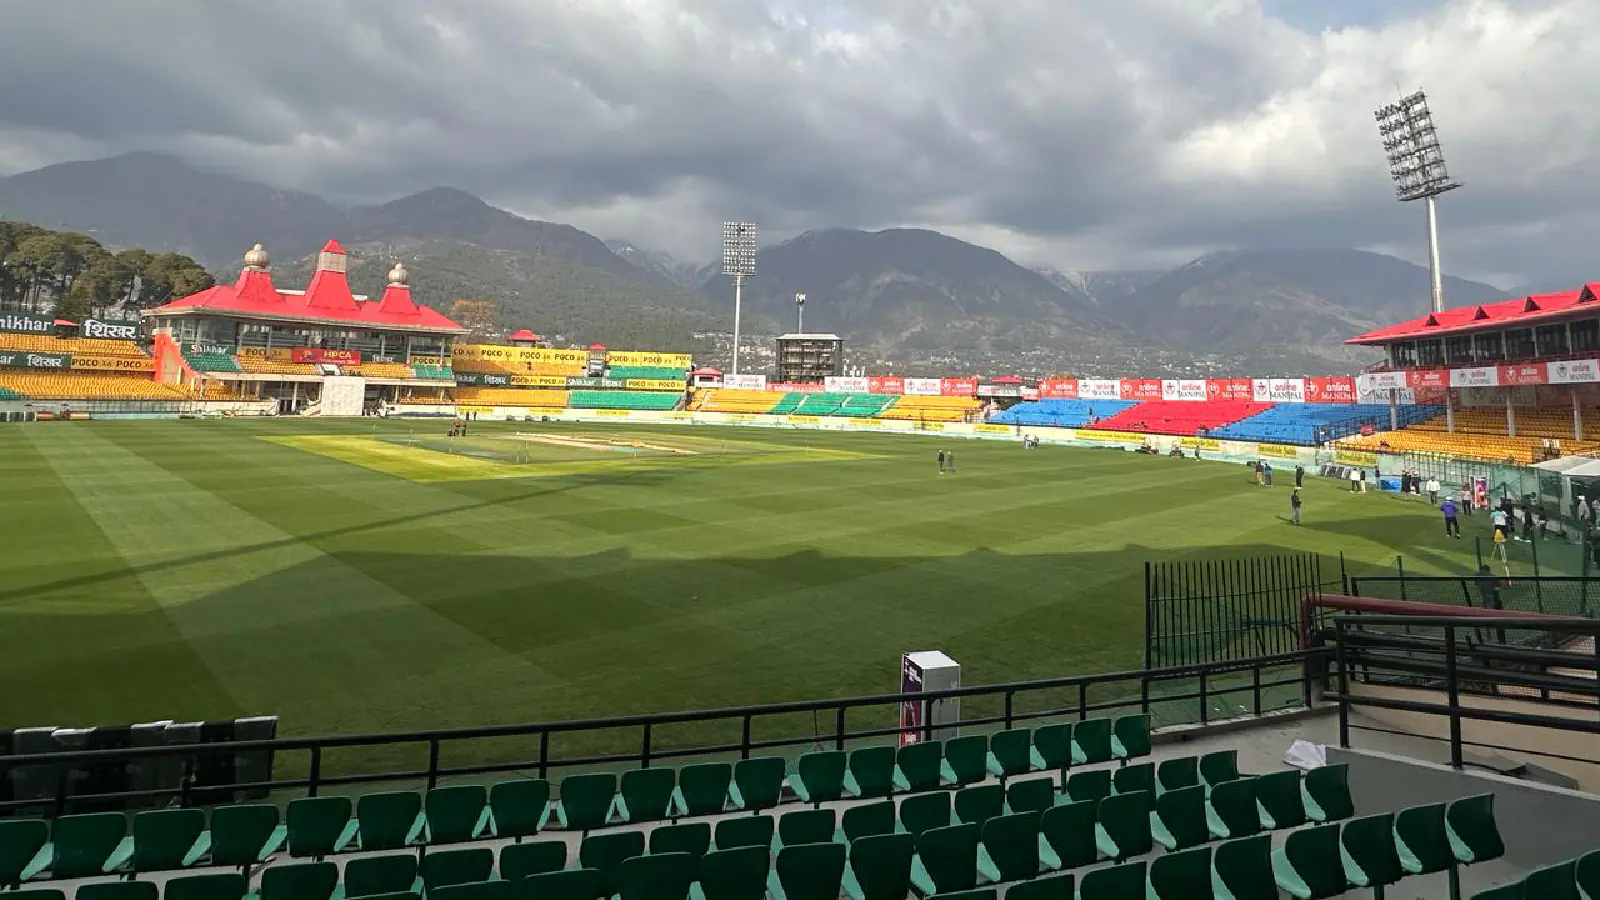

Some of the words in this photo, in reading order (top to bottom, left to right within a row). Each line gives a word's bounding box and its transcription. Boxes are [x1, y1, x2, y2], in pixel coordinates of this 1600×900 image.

[84, 319, 137, 338] शिखर
[324, 350, 352, 358] HPCA
[481, 349, 503, 357] POCO
[554, 353, 575, 361] POCO
[72, 358, 98, 366] POCO
[115, 360, 142, 368] POCO
[1226, 382, 1248, 391] online
[1275, 381, 1297, 391] online
[1325, 382, 1350, 391] online
[1375, 391, 1413, 401] MAIPAL
